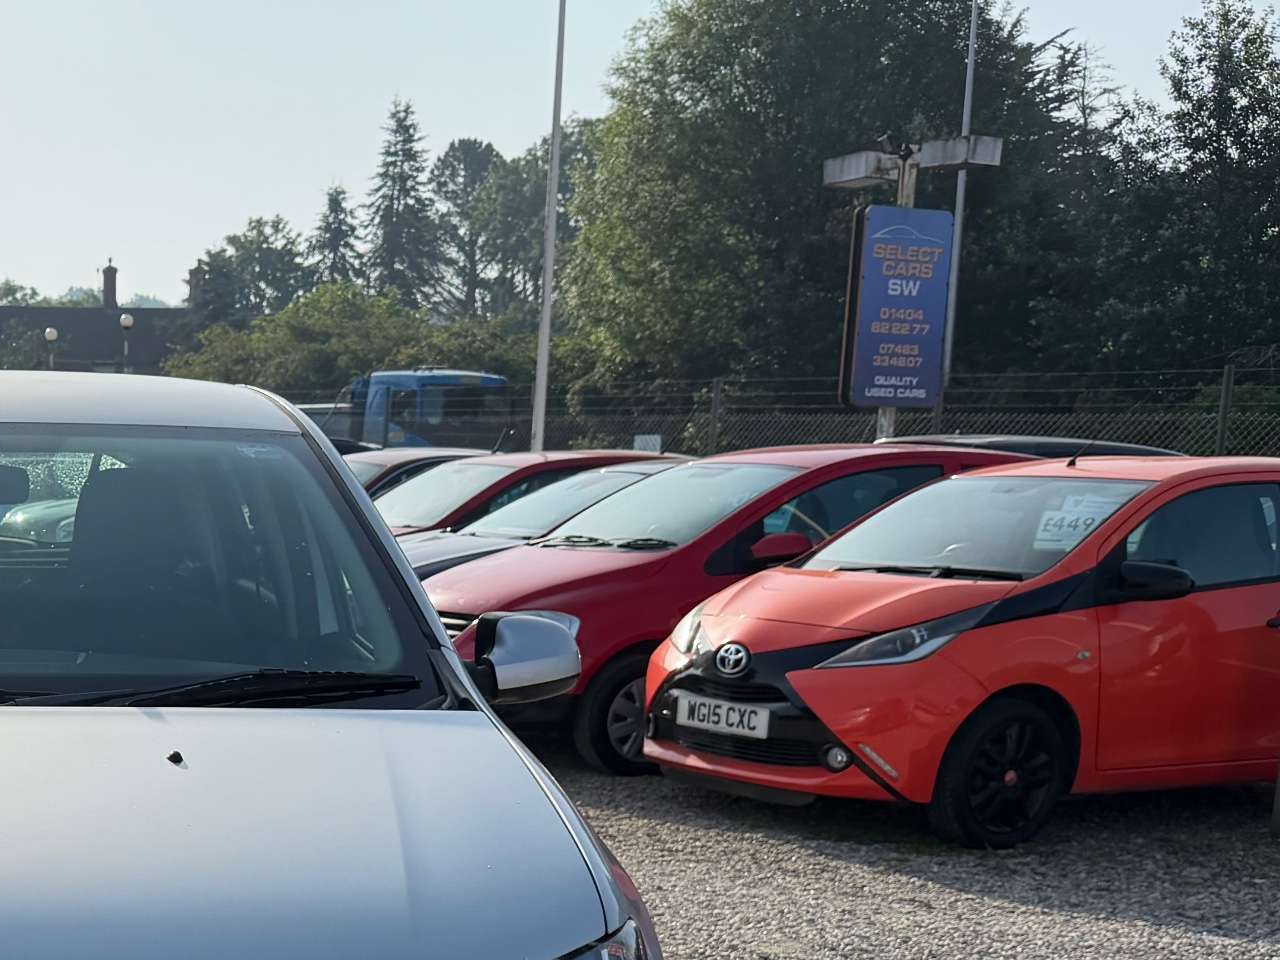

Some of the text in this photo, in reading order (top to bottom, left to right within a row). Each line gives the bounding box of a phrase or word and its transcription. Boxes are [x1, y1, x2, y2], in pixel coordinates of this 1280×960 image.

[872, 244, 944, 262] SELECT
[882, 261, 933, 278] CARS
[887, 280, 920, 296] SW
[880, 308, 923, 321] 01404
[874, 376, 919, 386] QUALITY
[865, 388, 926, 399] USED CARS
[687, 700, 758, 731] WG15 CXC
